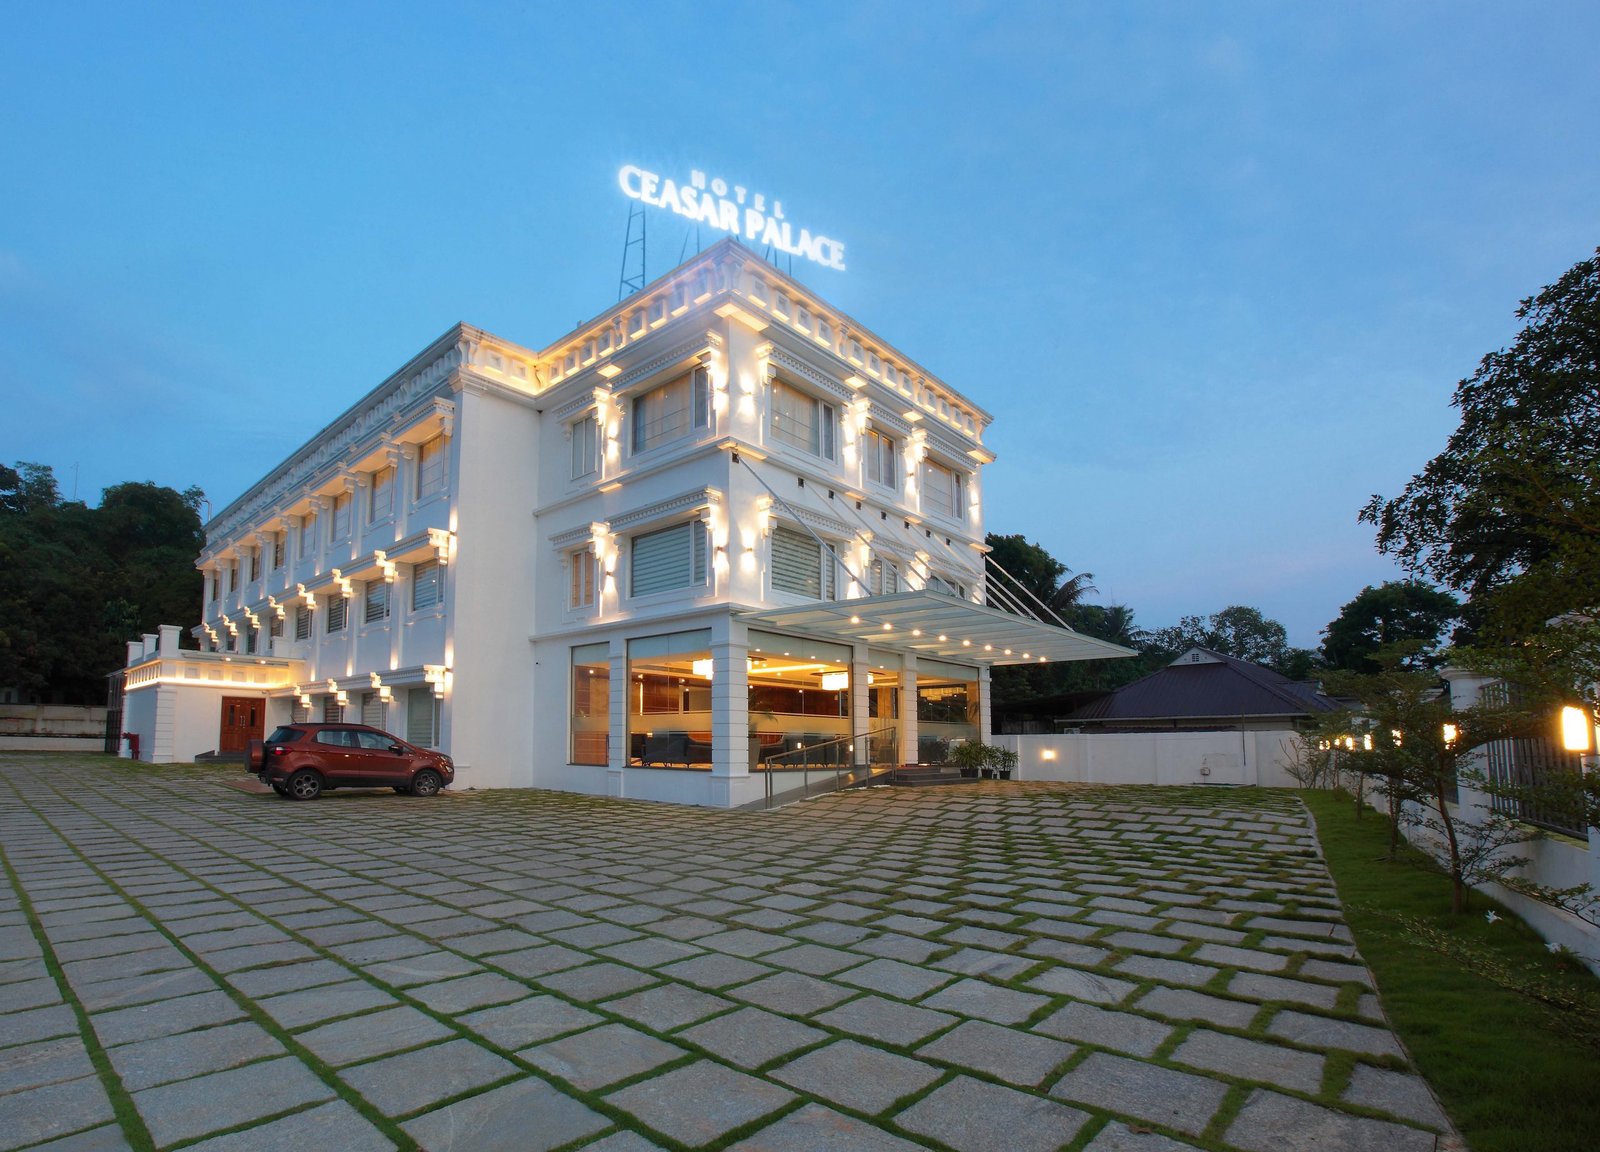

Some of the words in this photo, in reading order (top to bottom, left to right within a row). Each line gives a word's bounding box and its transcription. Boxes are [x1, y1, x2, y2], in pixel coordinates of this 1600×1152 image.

[618, 164, 740, 235] CEASAR
[745, 208, 846, 271] PALACE
[691, 169, 784, 219] HOTEL
